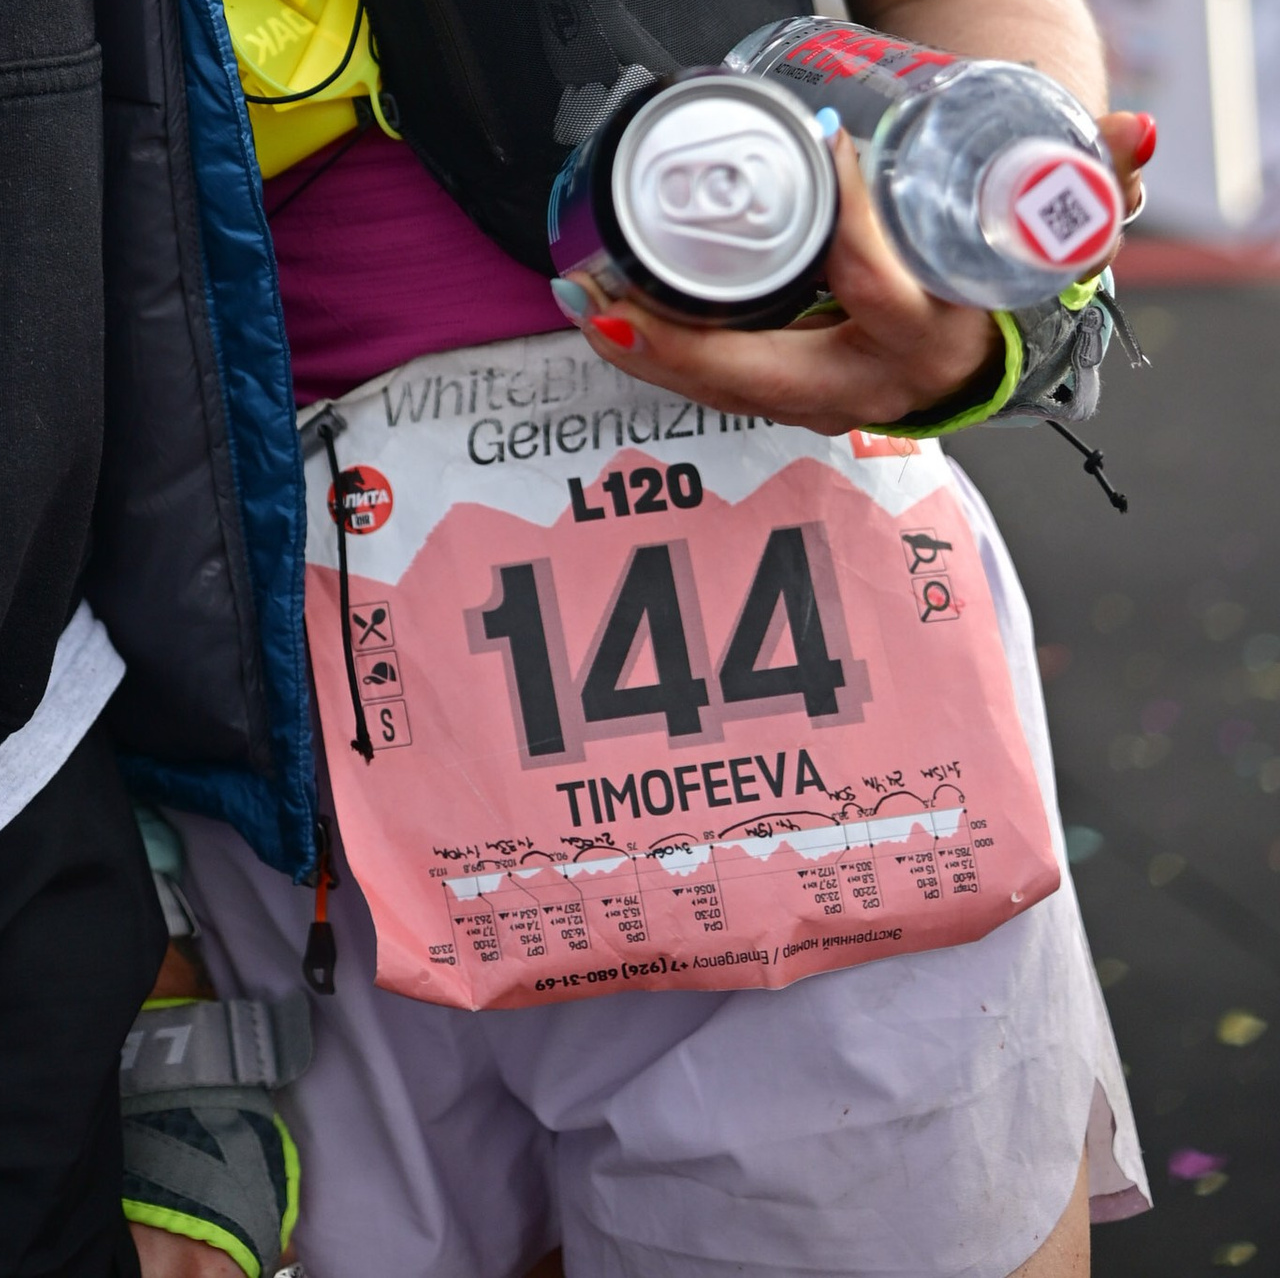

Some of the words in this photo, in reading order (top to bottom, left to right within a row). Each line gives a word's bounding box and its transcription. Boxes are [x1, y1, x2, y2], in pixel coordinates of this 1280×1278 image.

[568, 462, 704, 524] L120
[482, 526, 847, 758] 144
[380, 708, 396, 743] S
[556, 748, 826, 828] TIMOFEEVA
[971, 820, 987, 830] 500
[703, 831, 714, 839] 58
[627, 842, 638, 851] 75
[974, 838, 994, 848] 1000
[915, 852, 933, 863] 842
[955, 847, 971, 857] 785
[856, 861, 872, 871] 303
[961, 859, 974, 869] 7,5
[429, 868, 447, 877] 117,5
[817, 867, 835, 877] 1172
[925, 865, 935, 875] 15
[862, 873, 874, 883] 5,8
[917, 877, 938, 888] 18:10
[953, 872, 975, 883] 16:00
[819, 878, 838, 889] 29,7
[953, 884, 978, 893] Старт
[694, 884, 716, 895] 1056
[853, 886, 877, 898] 22:00
[624, 895, 639, 905] 719
[710, 896, 718, 906] 17
[815, 891, 839, 903] 23:30
[565, 903, 581, 913] 257
[623, 907, 641, 918] 15,3
[475, 915, 492, 924] 263
[520, 909, 537, 919] 634
[567, 915, 583, 924] 12,1
[695, 909, 720, 920] 07:30
[483, 926, 495, 936] 7,7
[527, 921, 540, 931] 7,4
[618, 920, 643, 932] 12:00
[520, 934, 542, 944] 19:15
[561, 928, 586, 939] 16:30
[473, 939, 496, 949] 21:00
[821, 928, 903, 951] Экстренный
[429, 944, 453, 955] 23:00
[783, 938, 819, 958] номер
[692, 950, 769, 969] Emergency
[772, 948, 780, 965] /
[622, 956, 667, 981] (926)
[670, 959, 689, 973] +7
[535, 967, 619, 992] 680-31-69
